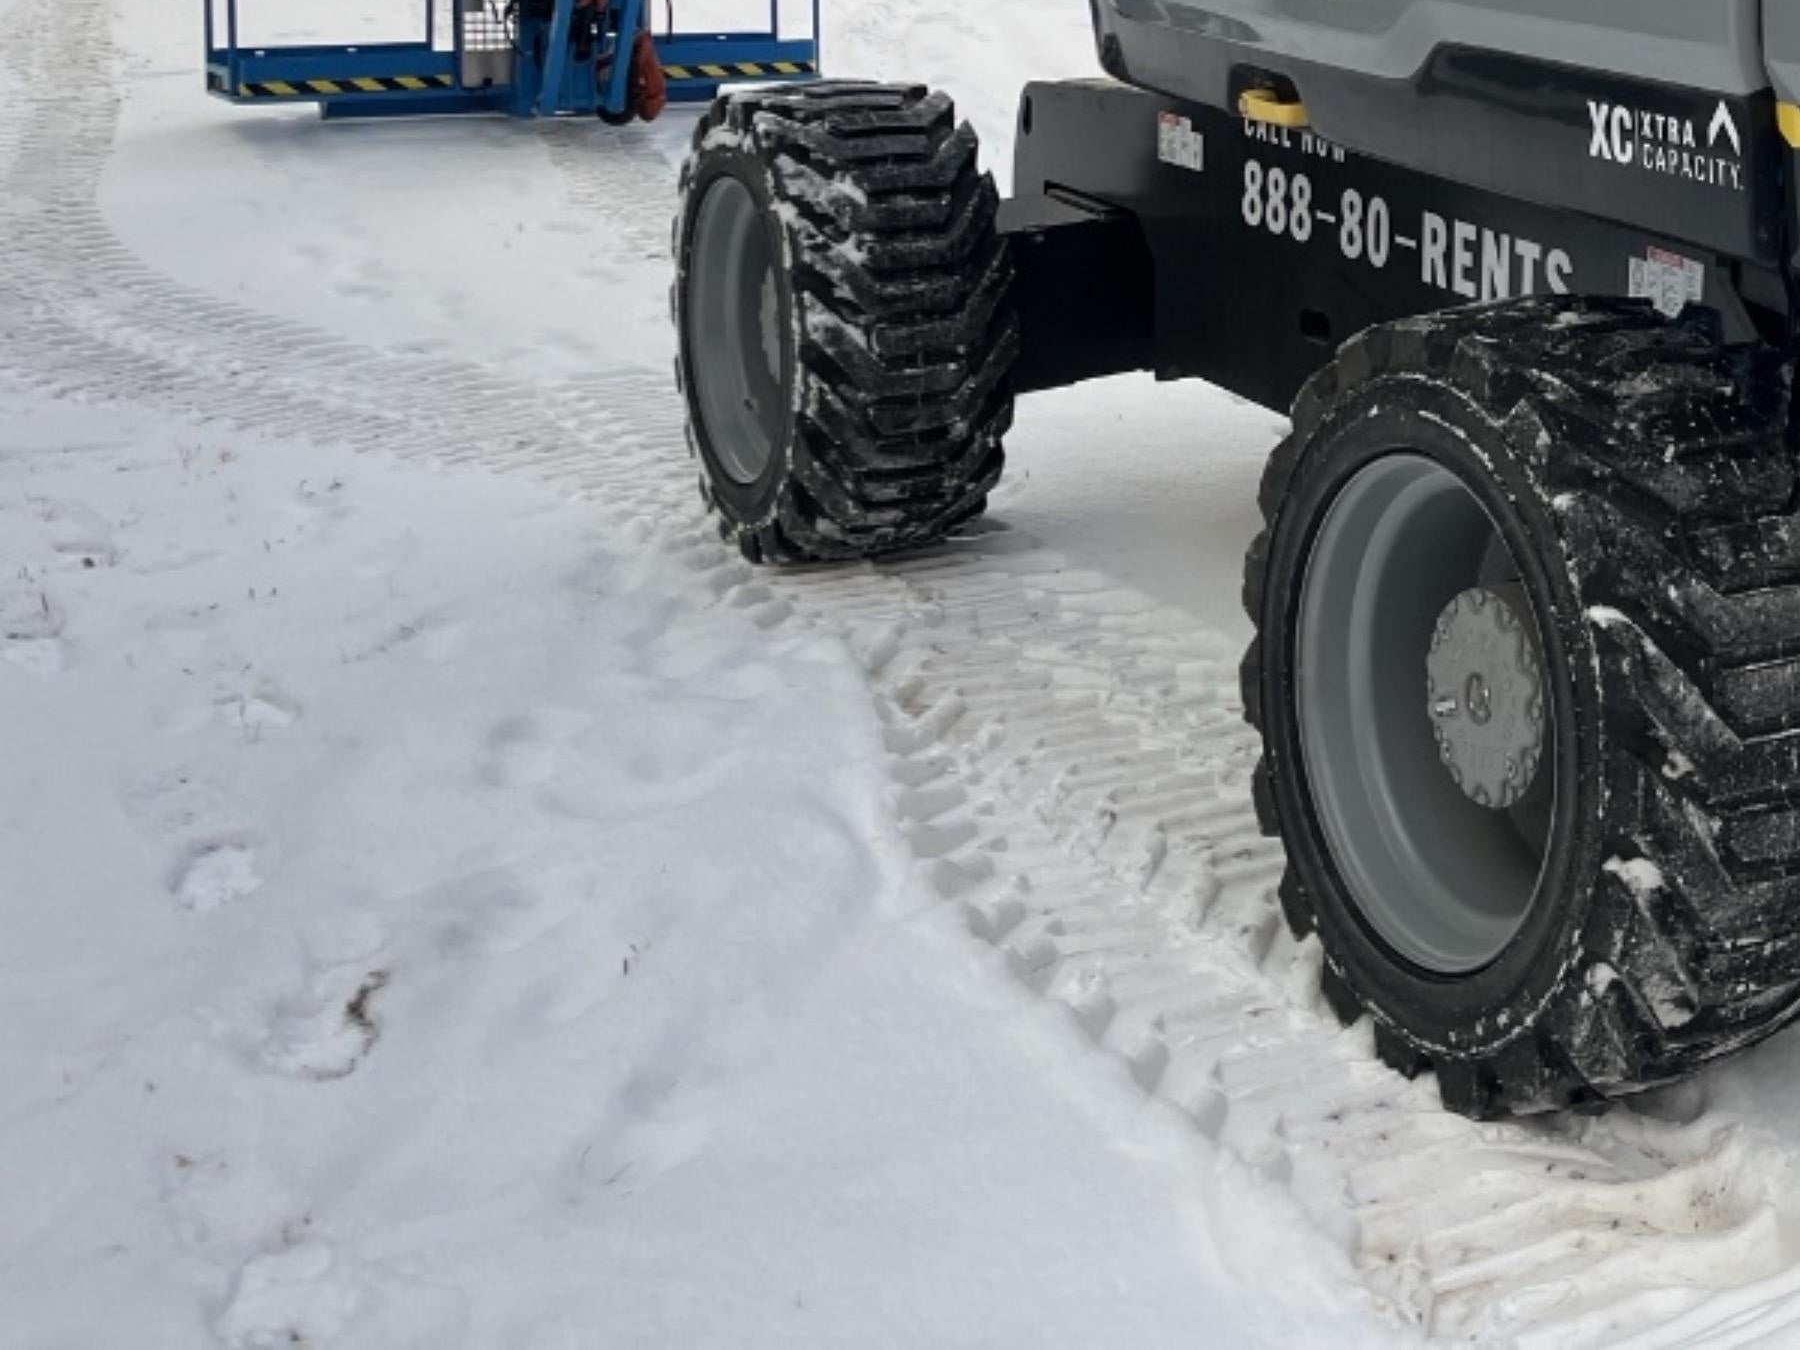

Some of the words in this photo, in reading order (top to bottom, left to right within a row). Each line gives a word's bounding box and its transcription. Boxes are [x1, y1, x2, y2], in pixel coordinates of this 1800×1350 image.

[1587, 99, 1633, 165] XC
[1641, 110, 1696, 149] XTRA
[1241, 159, 1574, 304] 888-80-RENTS
